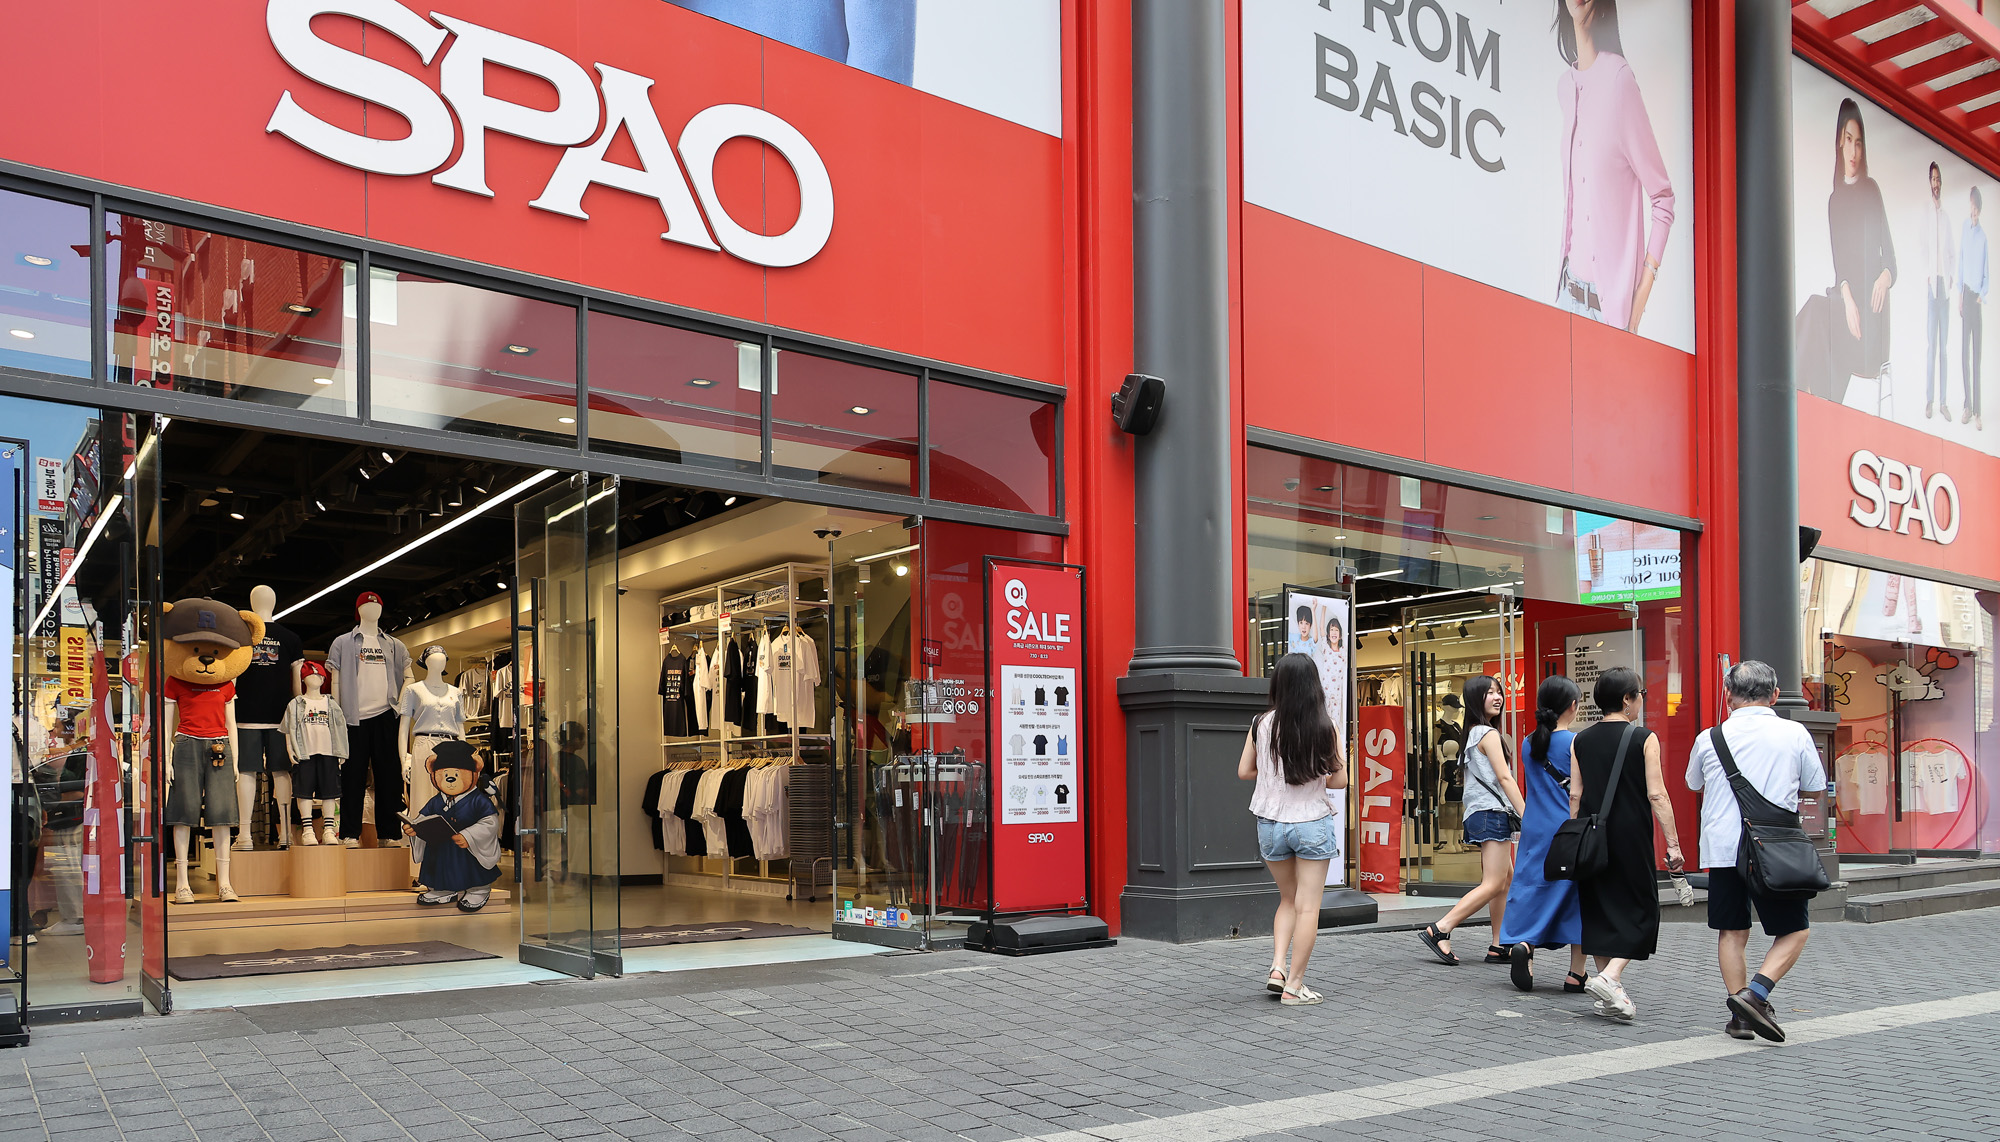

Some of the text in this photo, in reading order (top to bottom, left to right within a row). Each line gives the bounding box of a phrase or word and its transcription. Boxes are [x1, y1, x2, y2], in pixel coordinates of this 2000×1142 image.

[1318, 0, 1502, 93] ROM
[1314, 32, 1506, 173] BASIC
[265, 0, 835, 268] SPAO
[1848, 449, 1960, 545] SPAO
[1011, 587, 1024, 600] O!
[1006, 609, 1071, 643] SALE
[1574, 646, 1589, 658] 3F
[942, 687, 966, 698] 10:00
[1361, 728, 1396, 846] SALE
[1028, 832, 1054, 844] SPAO
[1360, 871, 1385, 883] SPAO
